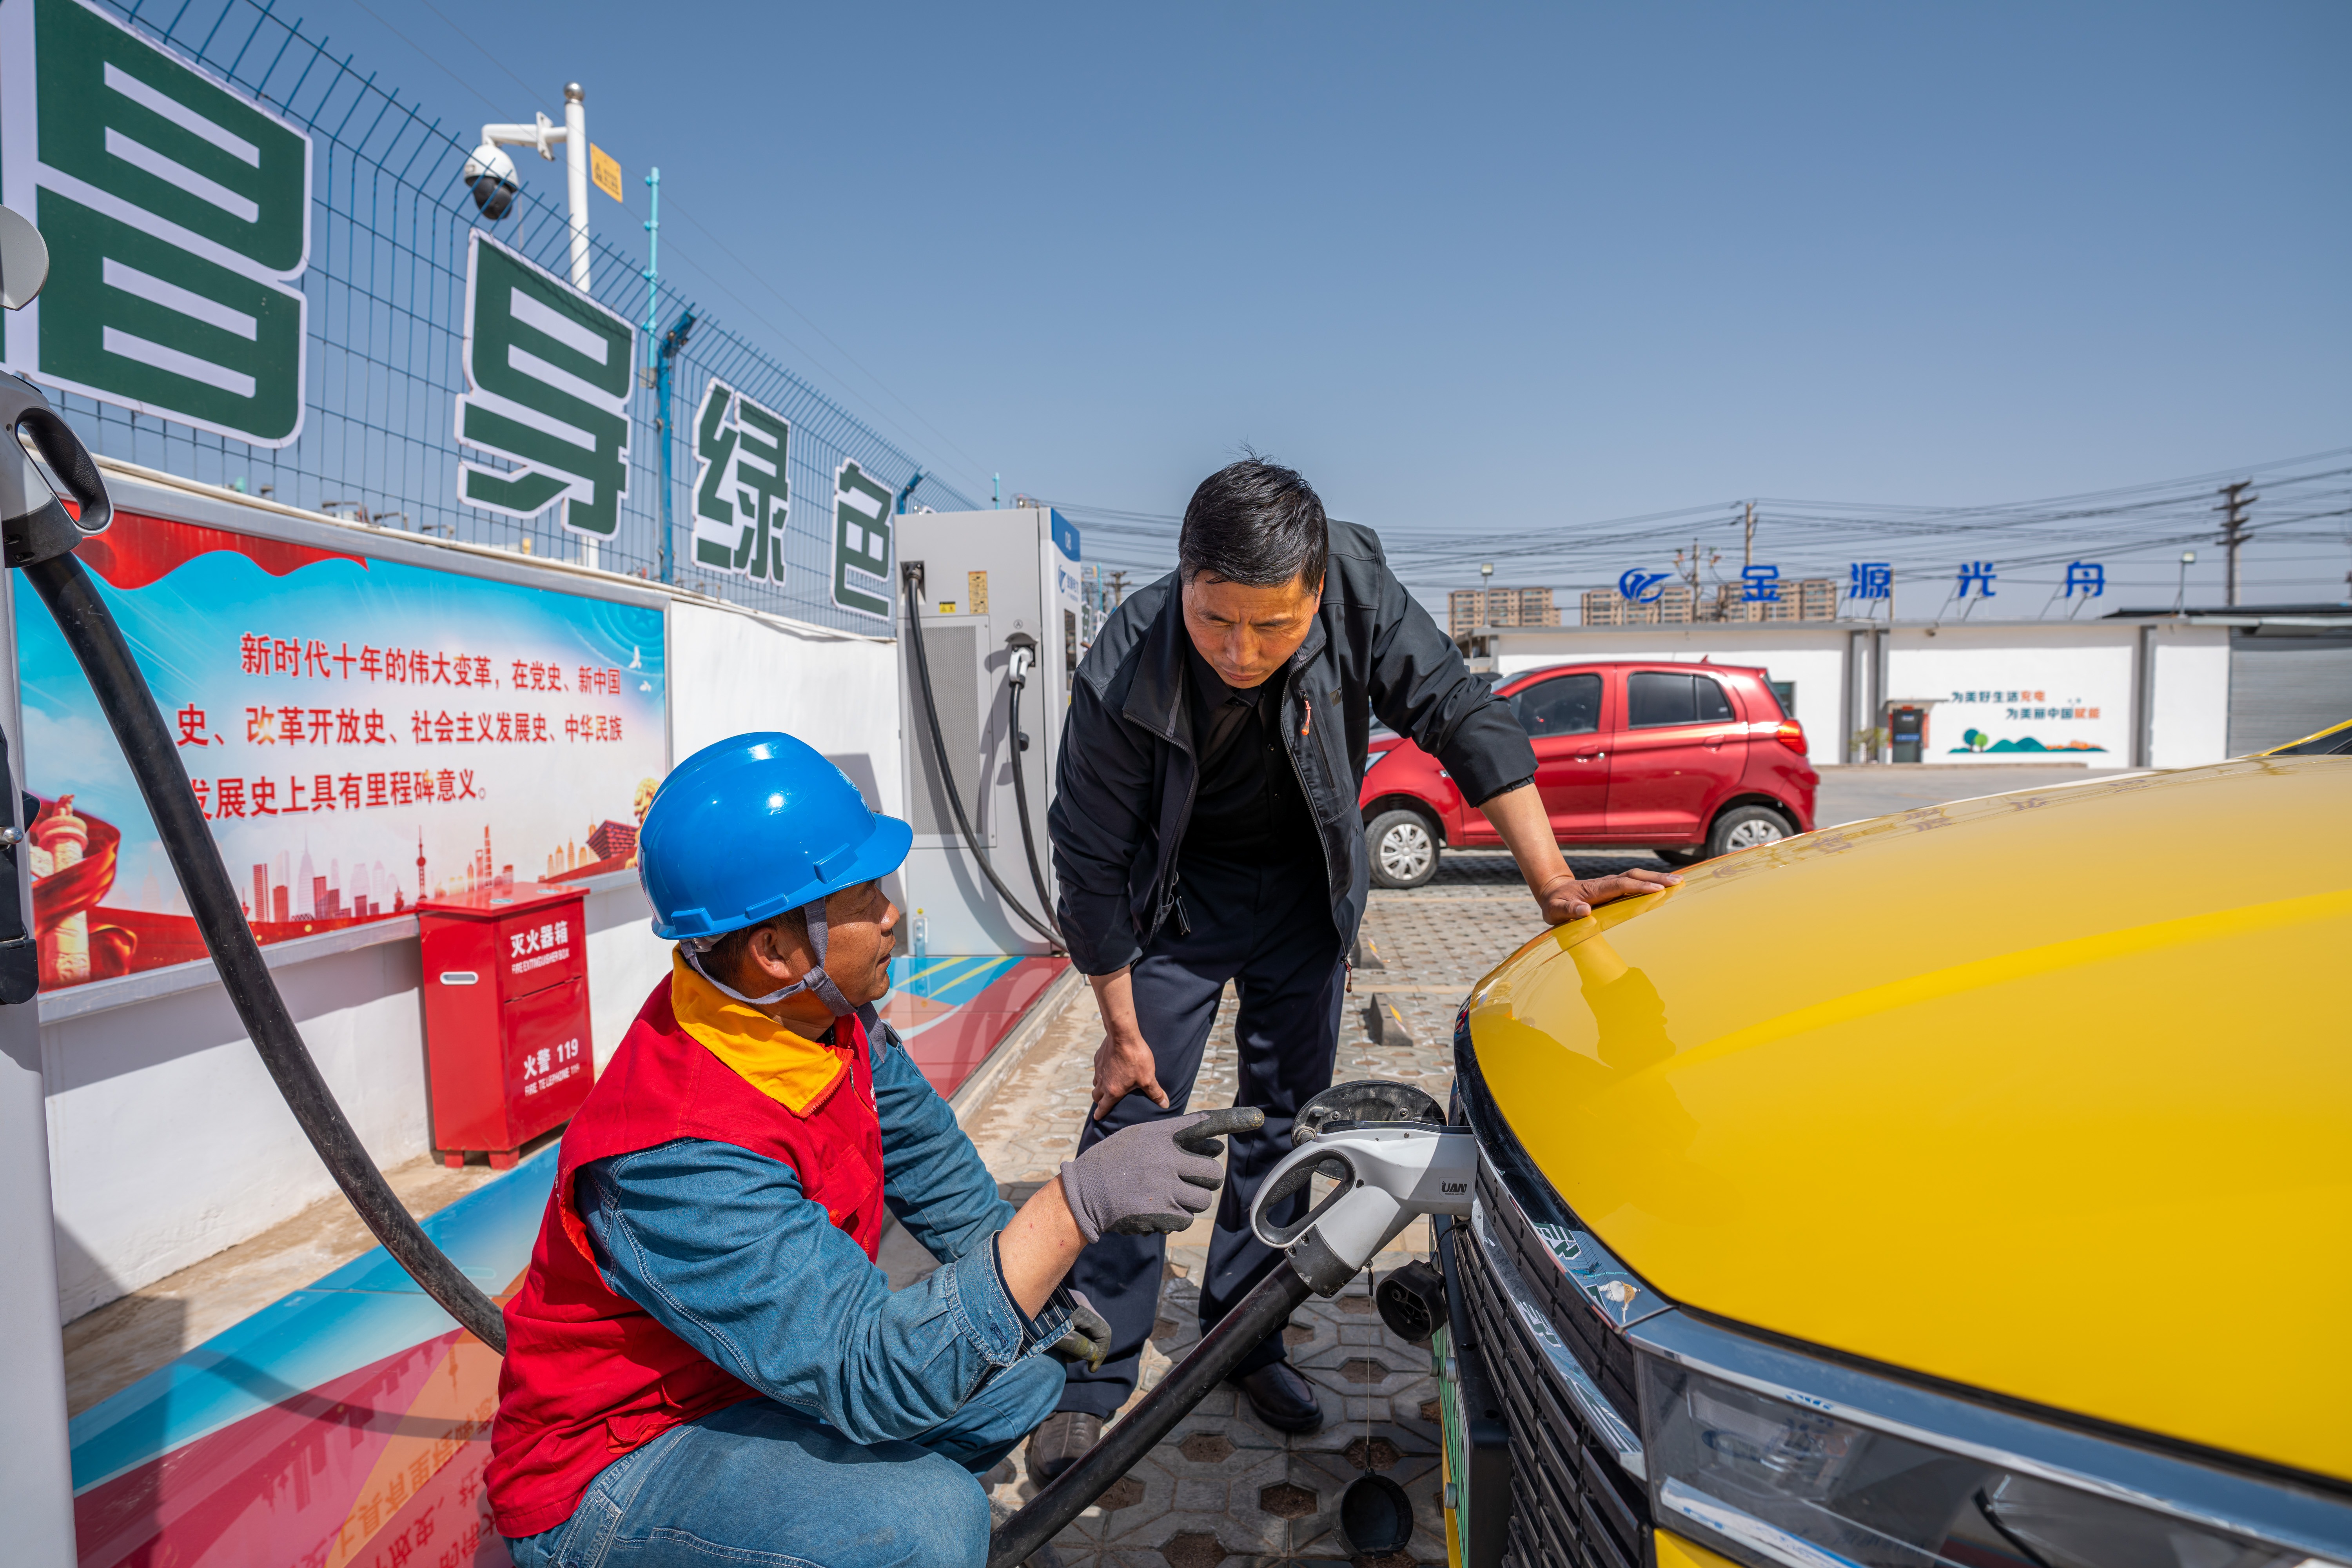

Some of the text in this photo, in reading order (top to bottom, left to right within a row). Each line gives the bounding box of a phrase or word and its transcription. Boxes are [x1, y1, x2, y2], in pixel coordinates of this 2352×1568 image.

[1740, 561, 2106, 603] 金源光舟
[510, 920, 568, 958] 灭火器箱
[512, 962, 523, 975] FIRE
[558, 947, 570, 960] BOX
[524, 1038, 578, 1081] 火警 119
[525, 1082, 538, 1097] FIRE
[1441, 1181, 1468, 1193] UAN
